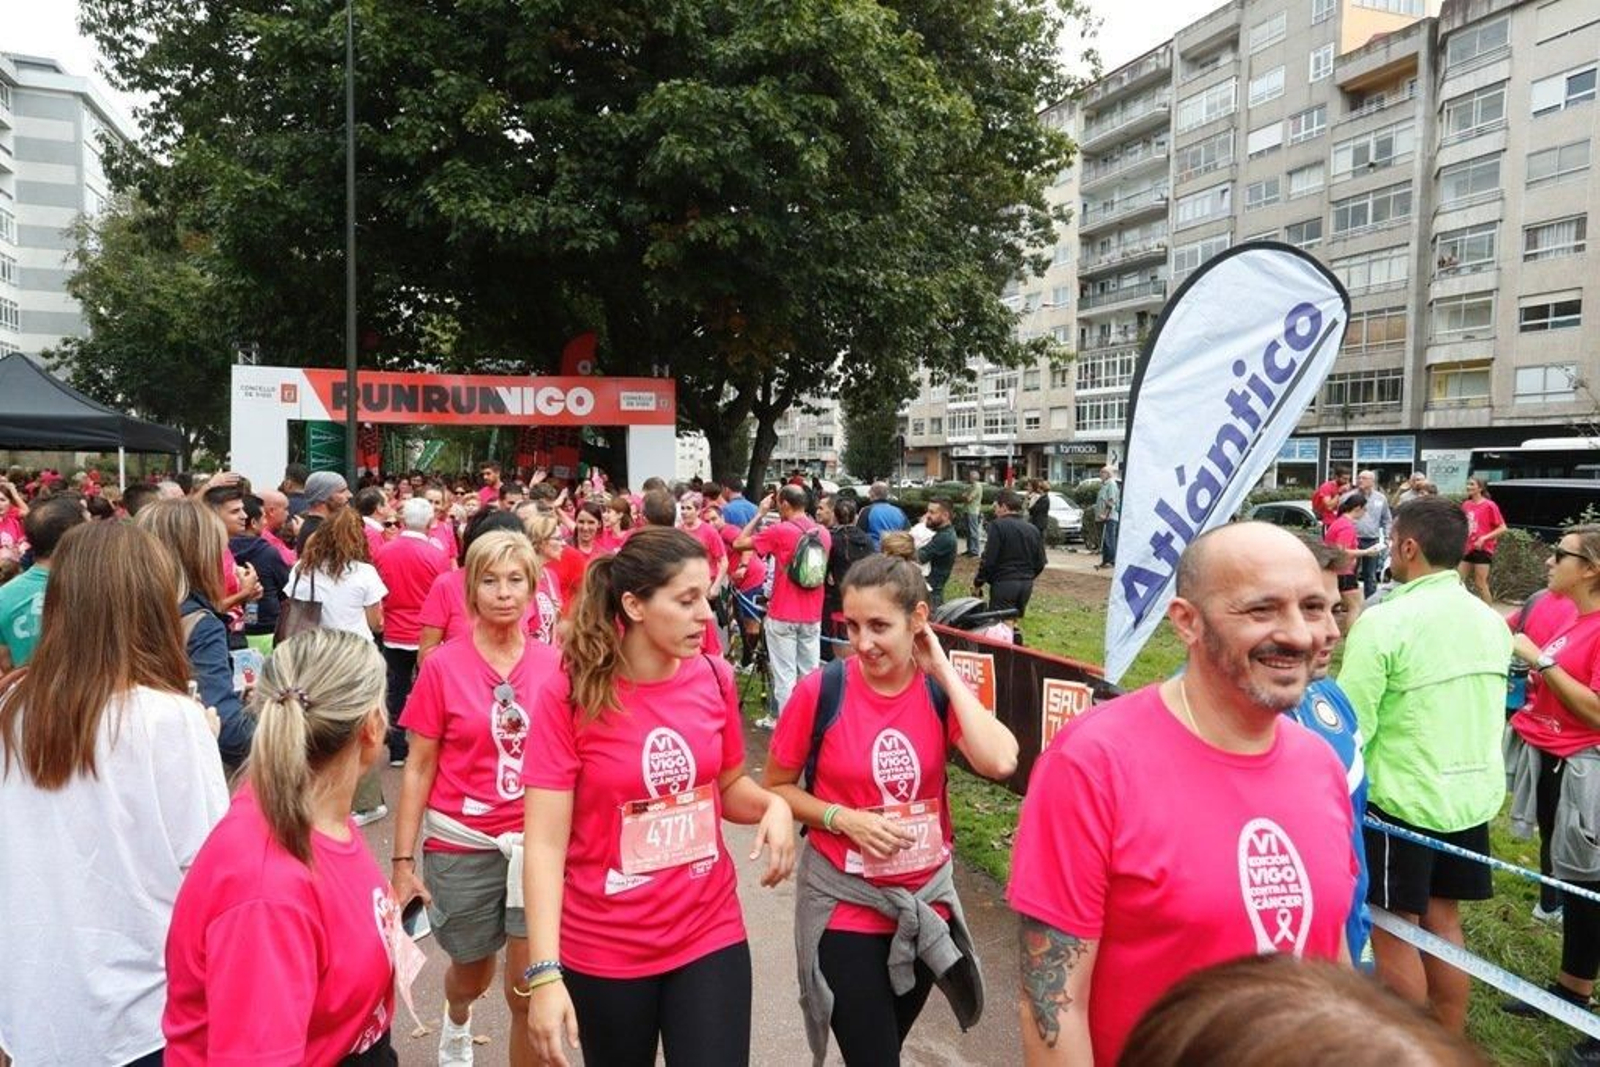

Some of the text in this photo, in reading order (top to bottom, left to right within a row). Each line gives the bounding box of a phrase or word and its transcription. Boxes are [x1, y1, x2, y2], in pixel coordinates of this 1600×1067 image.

[1120, 301, 1323, 624] Atlántico
[1049, 687, 1088, 717] SAV
[653, 736, 673, 751] VI
[881, 737, 899, 750] VI
[650, 755, 686, 771] VIGO
[879, 755, 911, 768] VIGO
[1251, 833, 1278, 854] VI
[1249, 866, 1297, 886] VIGO
